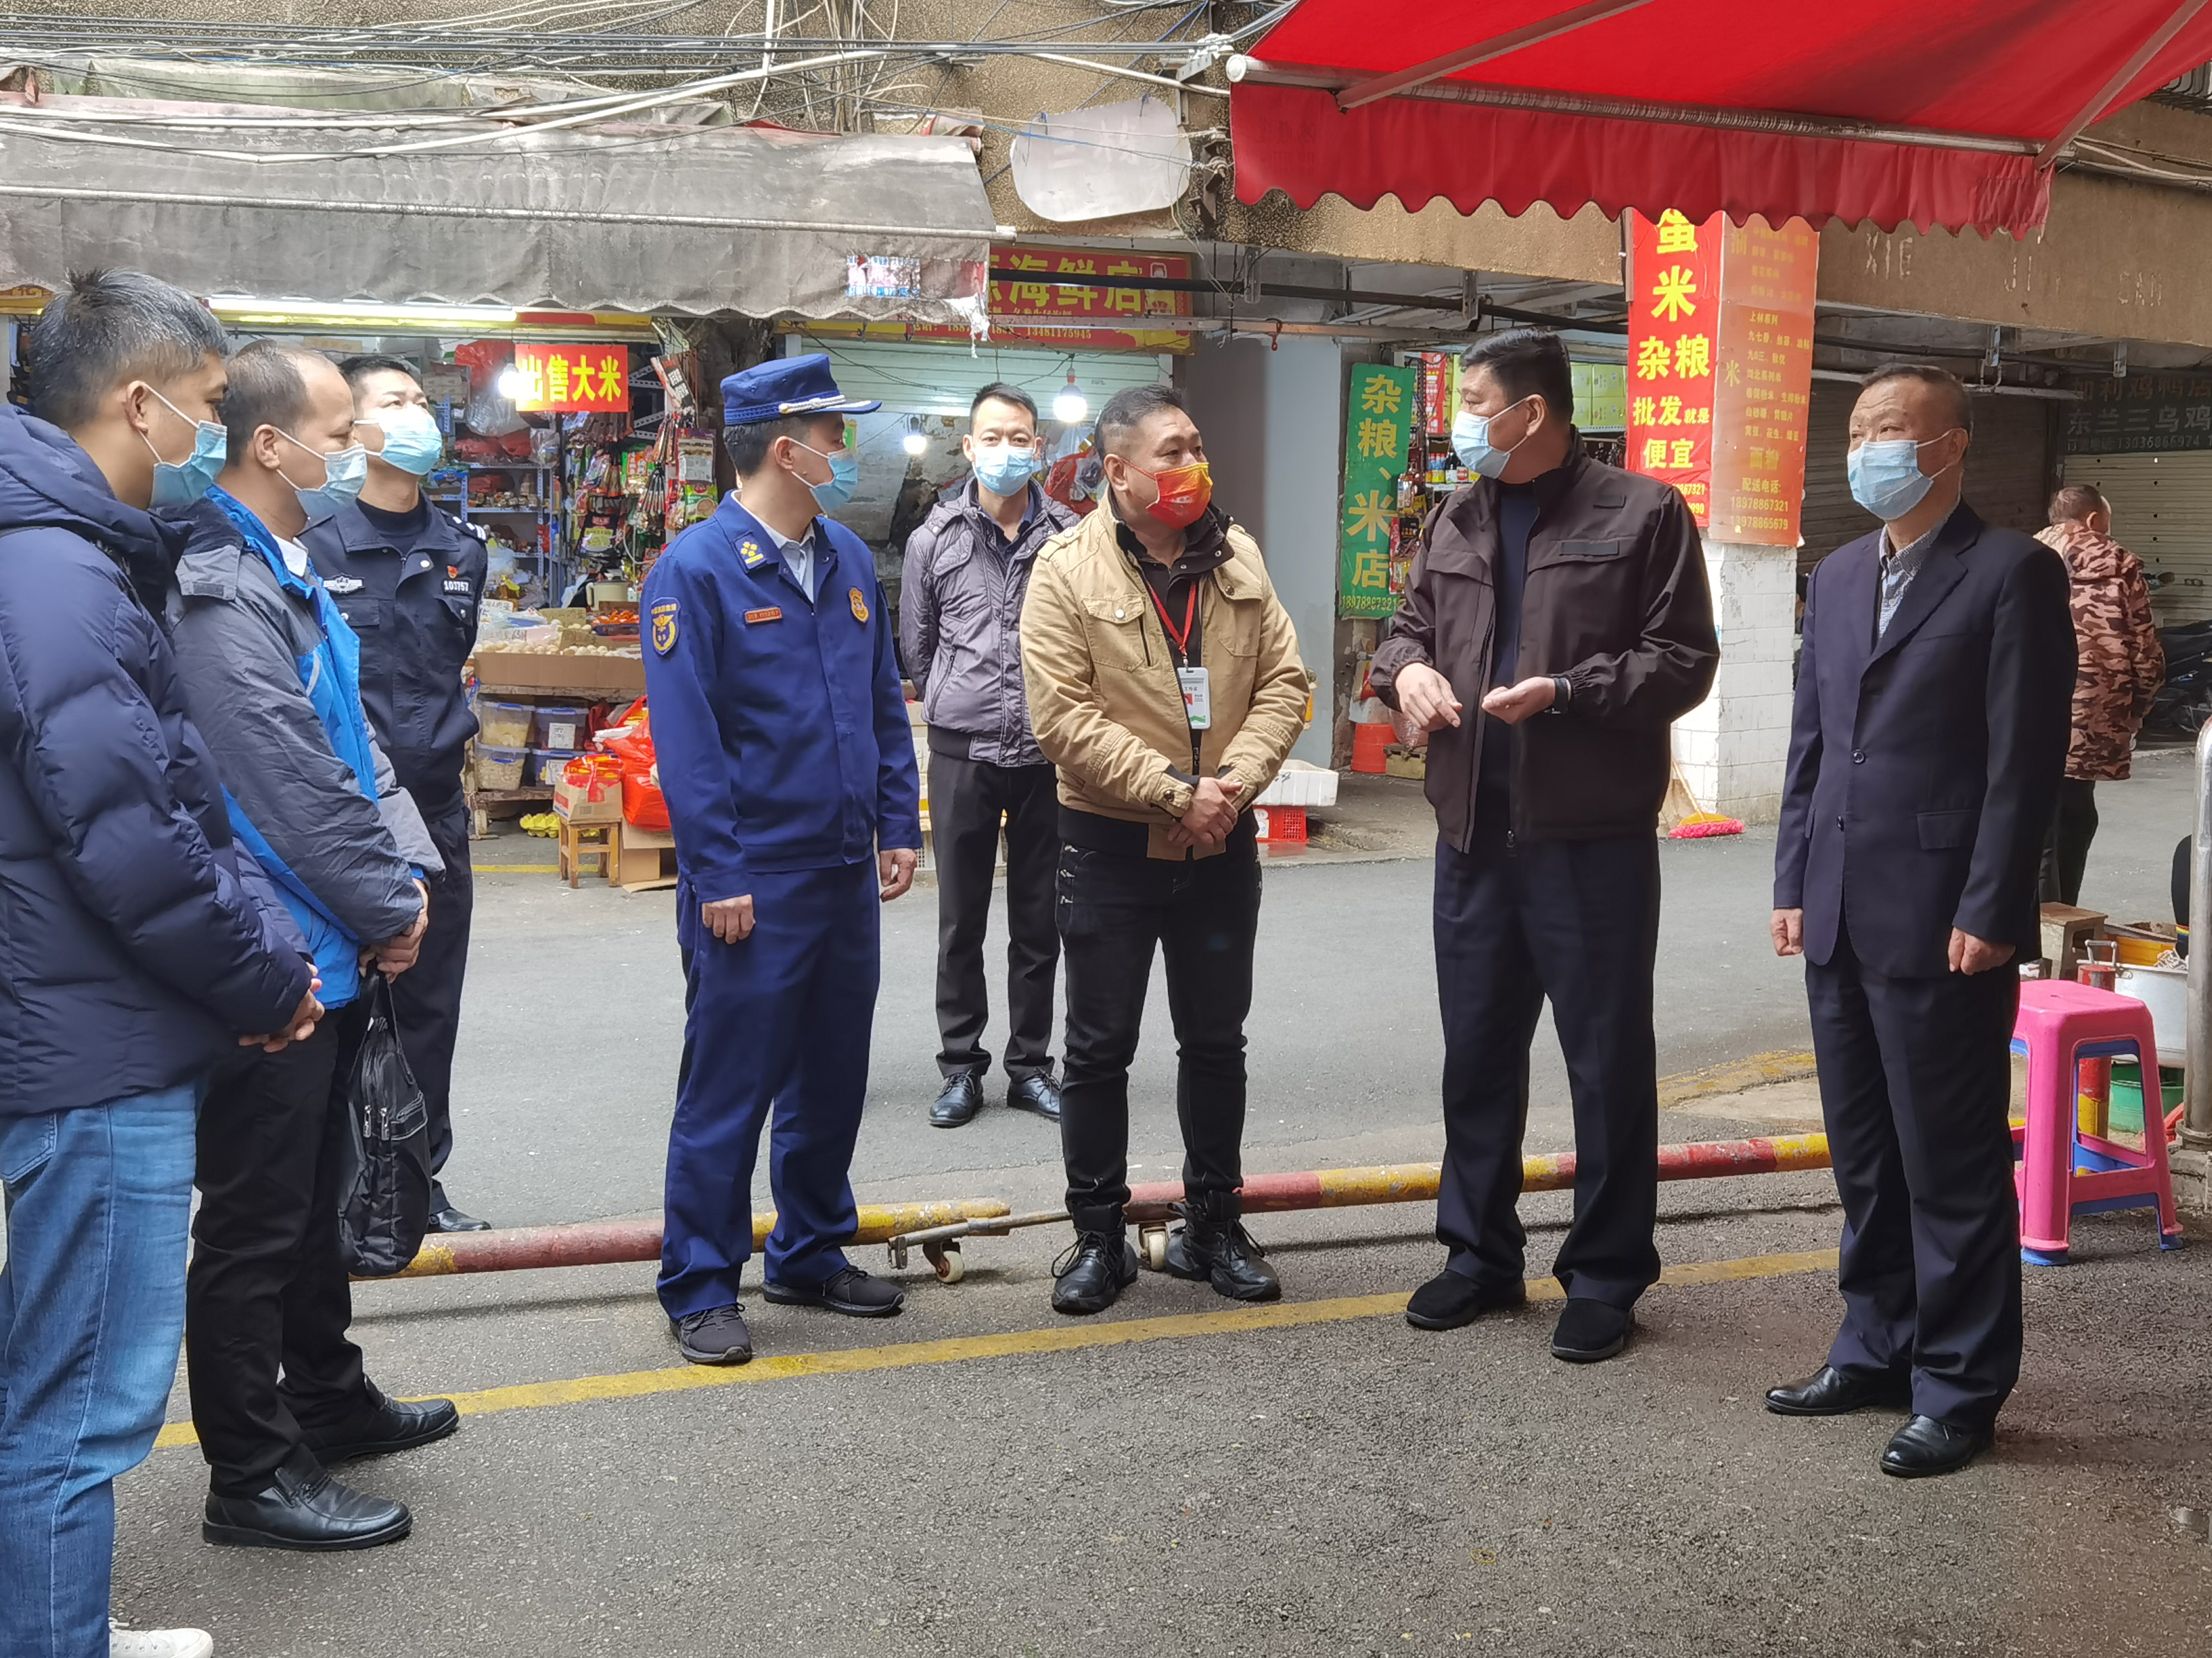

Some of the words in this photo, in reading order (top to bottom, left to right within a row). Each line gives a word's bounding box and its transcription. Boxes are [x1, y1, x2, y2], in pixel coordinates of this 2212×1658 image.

[1637, 334, 1710, 380] 杂粮
[521, 354, 621, 402] 出售大米
[1724, 360, 1741, 387] 米
[2067, 405, 2212, 435] 东兰三乌鸡
[1643, 439, 1694, 469] 便宜
[1731, 496, 1788, 511] 18978867321
